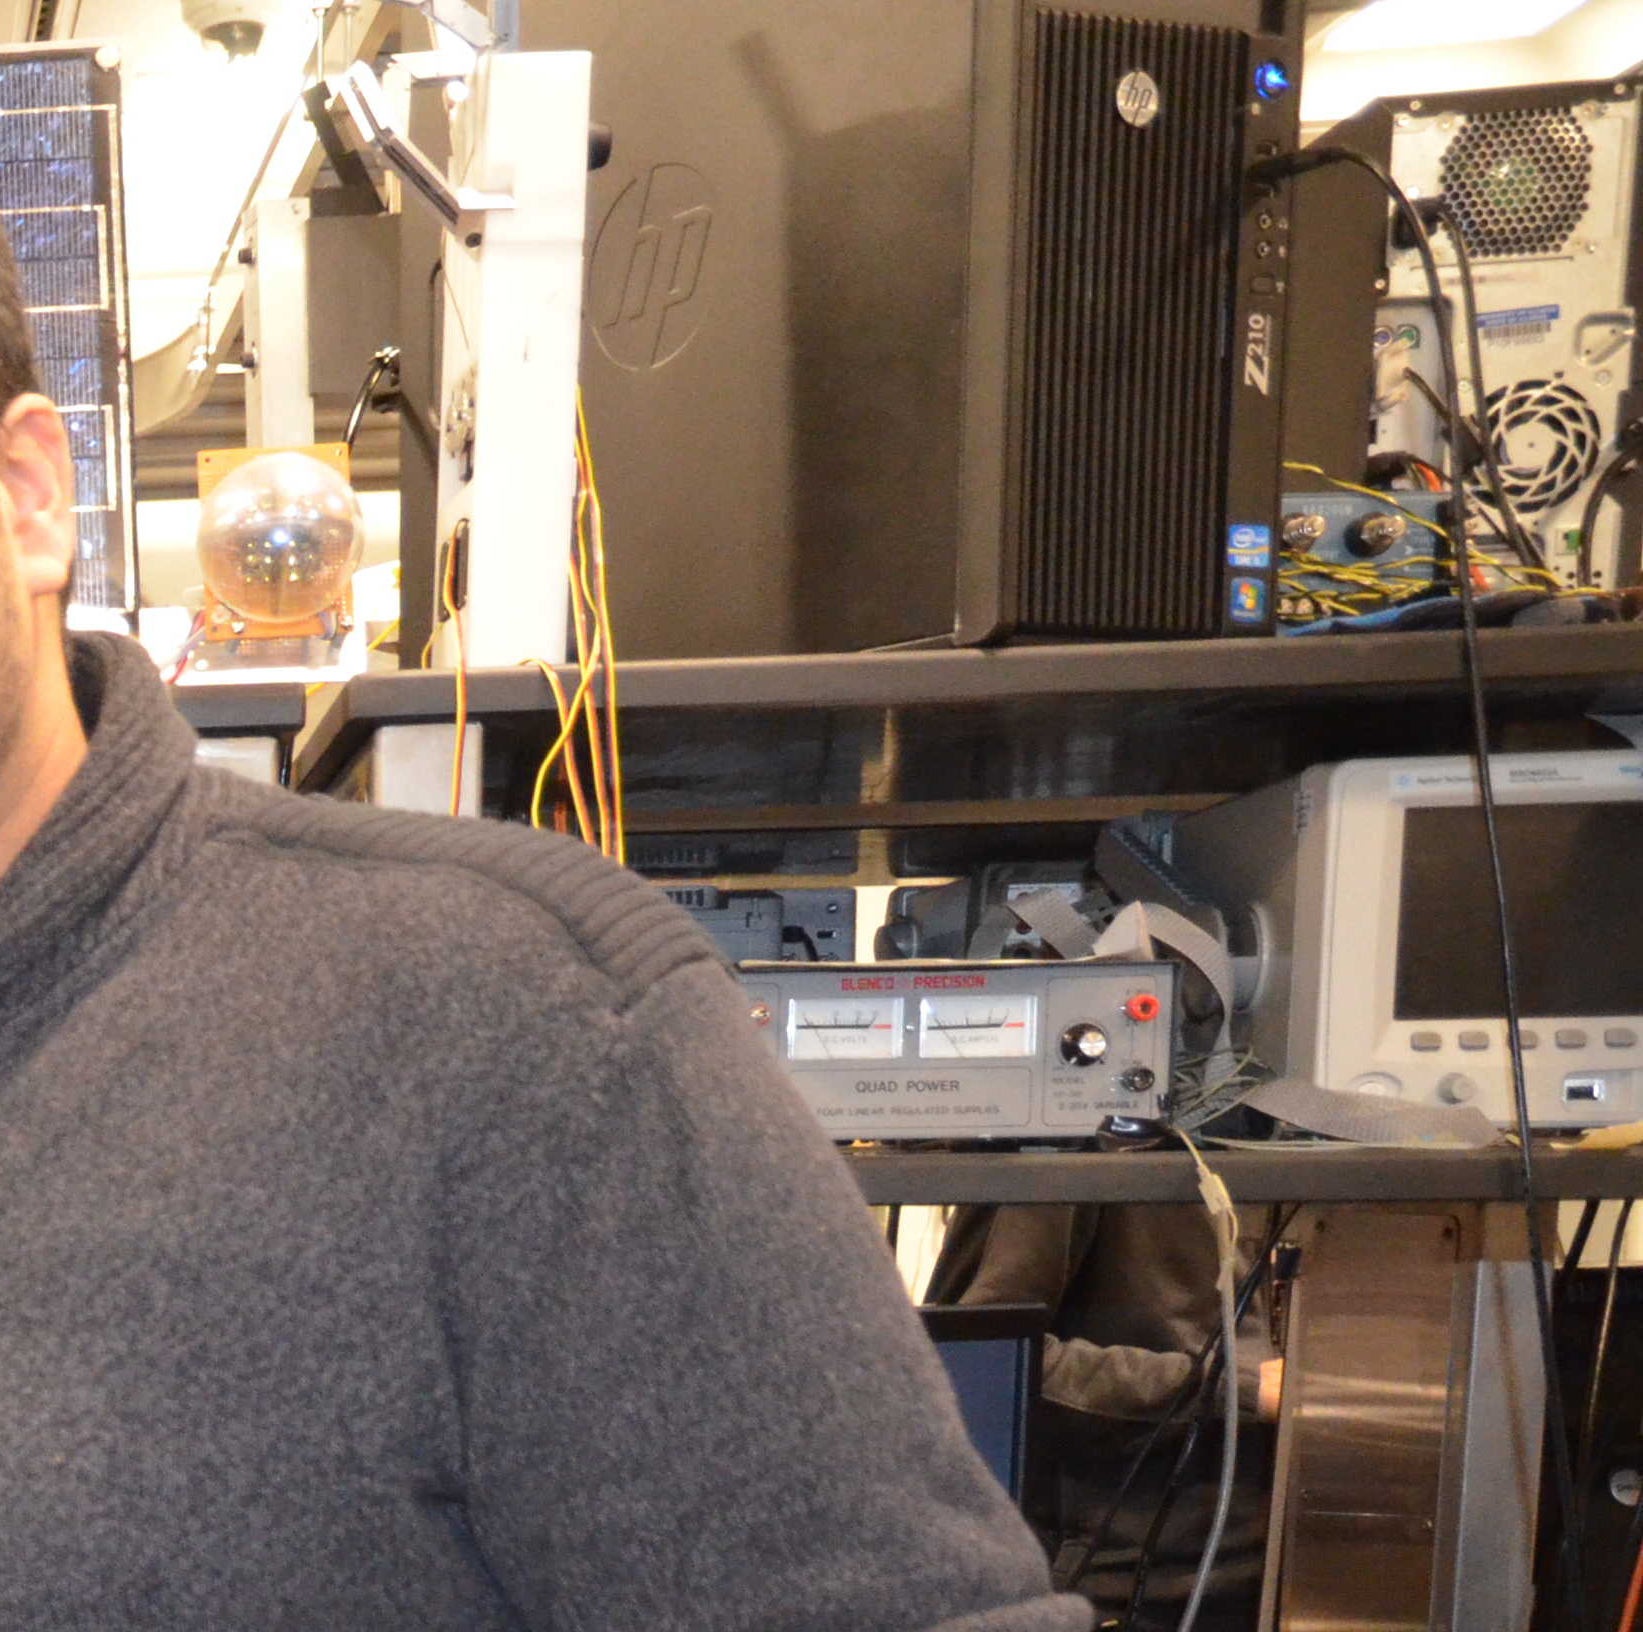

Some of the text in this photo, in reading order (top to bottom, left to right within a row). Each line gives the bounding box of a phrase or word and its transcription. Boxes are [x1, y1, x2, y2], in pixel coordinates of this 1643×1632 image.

[1244, 313, 1270, 396] Z210
[841, 975, 986, 991] ELENCO PRECISION
[855, 1080, 960, 1093] QUAD POWER
[817, 1104, 1000, 1116] FOUR LINEAR REGULATED SUPPLIES
